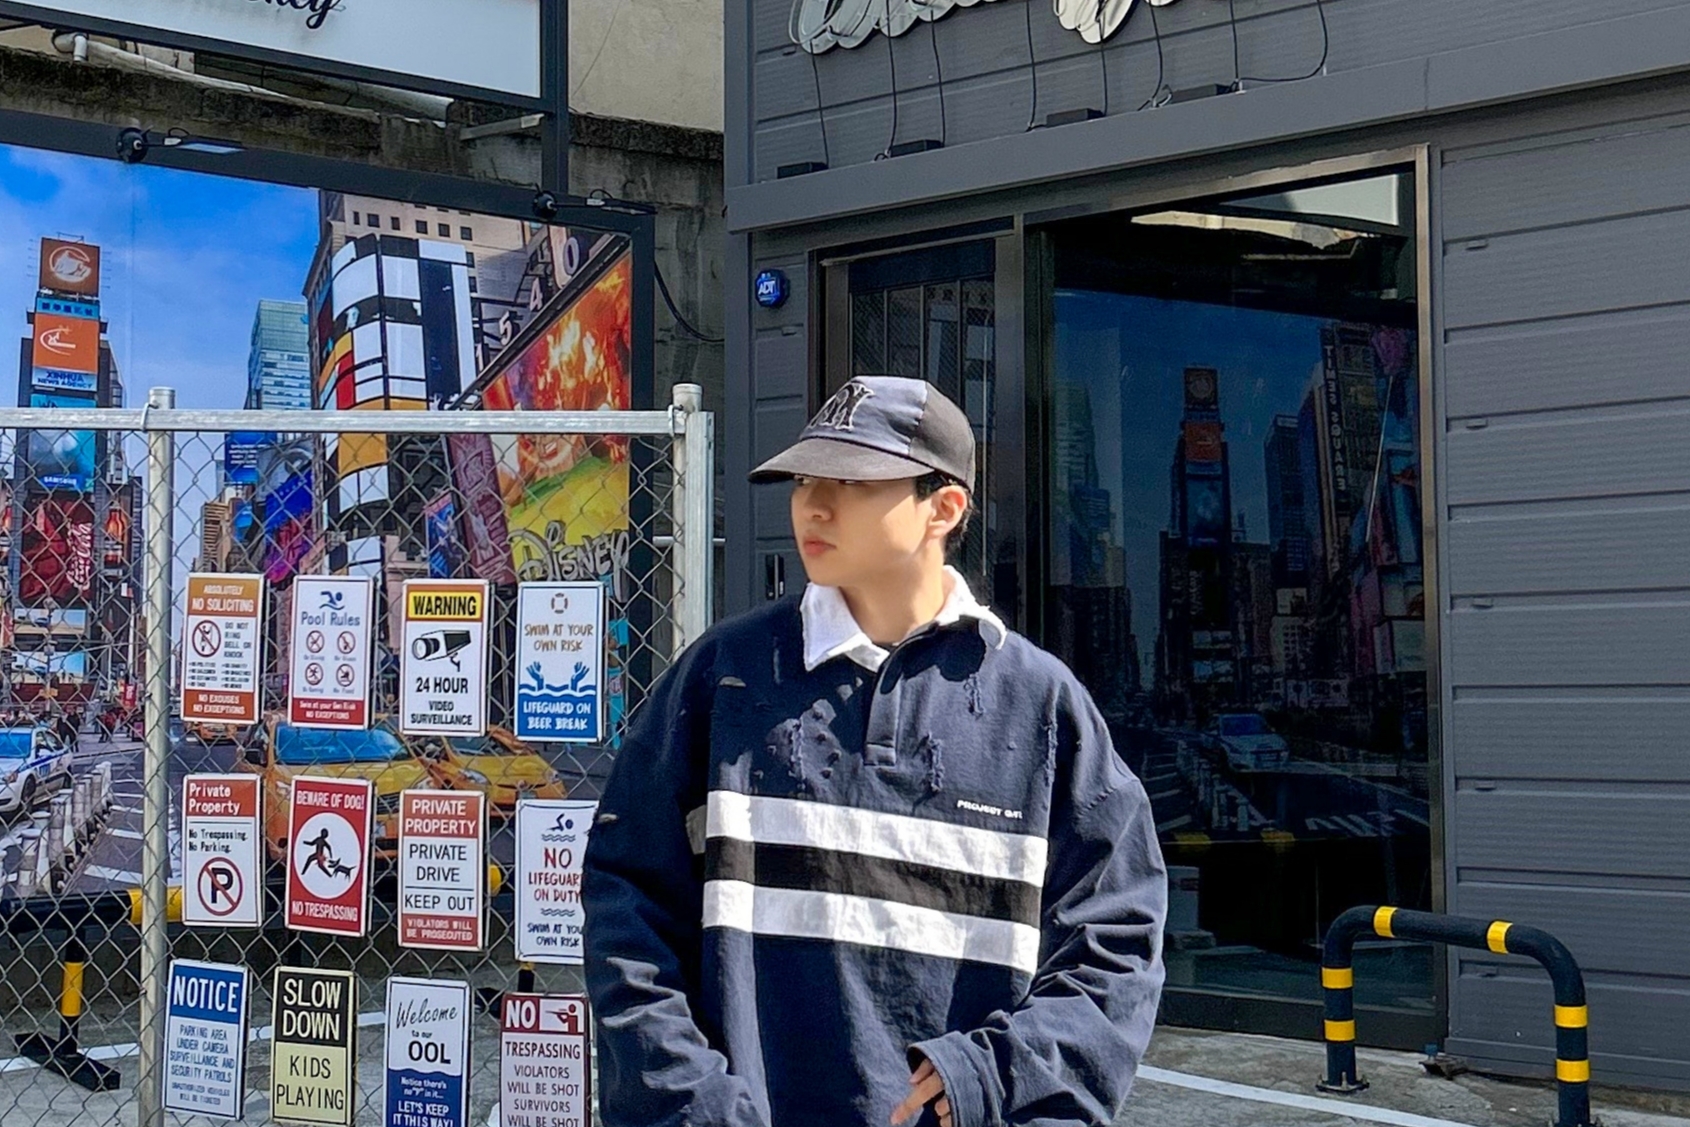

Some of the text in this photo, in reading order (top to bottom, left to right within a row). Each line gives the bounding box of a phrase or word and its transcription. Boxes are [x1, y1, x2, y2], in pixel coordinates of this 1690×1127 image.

[758, 280, 775, 295] ADT
[45, 370, 84, 382] XINHUA
[61, 379, 94, 389] AGENCY
[43, 475, 77, 486] SAMSUNG
[204, 585, 244, 595] ABSOLUTELY
[192, 598, 254, 612] NO SOLICITING
[413, 596, 476, 616] WARNING
[301, 612, 360, 626] Pool Rules
[525, 624, 594, 636] SWIM AT YOUR
[534, 640, 583, 651] OWN RISK
[416, 677, 468, 693] 24 HOUR
[199, 694, 208, 702] NO
[193, 704, 202, 712] NO
[429, 701, 454, 711] VIDEO
[523, 701, 591, 714] LIFEGUARD ON
[411, 713, 472, 725] SURVEILLANCE
[528, 717, 588, 730] BEER BREAK
[189, 783, 230, 797] Private
[189, 799, 240, 815] Property
[296, 791, 365, 810] BEWARE OF DOG!
[412, 799, 466, 816] PRIVATE
[957, 800, 1002, 816] PROJECT
[189, 830, 197, 838] No
[405, 819, 477, 834] PROPERTY
[188, 842, 197, 851] No
[409, 843, 467, 861] PRIVATE
[544, 847, 572, 869] NO
[417, 866, 460, 882] DRIVE
[529, 872, 582, 886] LIFEGUAR
[405, 894, 474, 911] KEEP OUT
[534, 889, 581, 904] ON DUTY
[292, 901, 358, 922] NO TRESPASSING
[408, 919, 472, 930] VIOLATORS WILL
[527, 922, 582, 934] SWIM AT YOU
[407, 929, 473, 940] BE PROSECUTED
[536, 936, 580, 947] OWN RISK
[173, 975, 239, 1013] NOTICE
[283, 978, 342, 1009] SLOW
[396, 998, 458, 1029] Welcome
[506, 1000, 536, 1029] NO
[283, 1009, 340, 1040] DOWN
[180, 1024, 227, 1041] PARKING AREA
[177, 1038, 229, 1054] UNDER CAMERA
[408, 1041, 451, 1064] OOL
[505, 1041, 580, 1059] TRESPASSING
[170, 1050, 235, 1069] SURVEILLANCE AND
[290, 1055, 331, 1079] KIDS
[171, 1065, 232, 1083] SECURITY PATROLS
[514, 1065, 570, 1079] VIOLATORS
[507, 1082, 579, 1096] WILL BE SHOT
[276, 1084, 344, 1110] PLAYING
[398, 1100, 449, 1116] LET'S KEEP
[514, 1099, 570, 1113] SURVIVORS
[393, 1113, 402, 1125] IT
[404, 1114, 428, 1127] THIS
[507, 1115, 530, 1127] WILL
